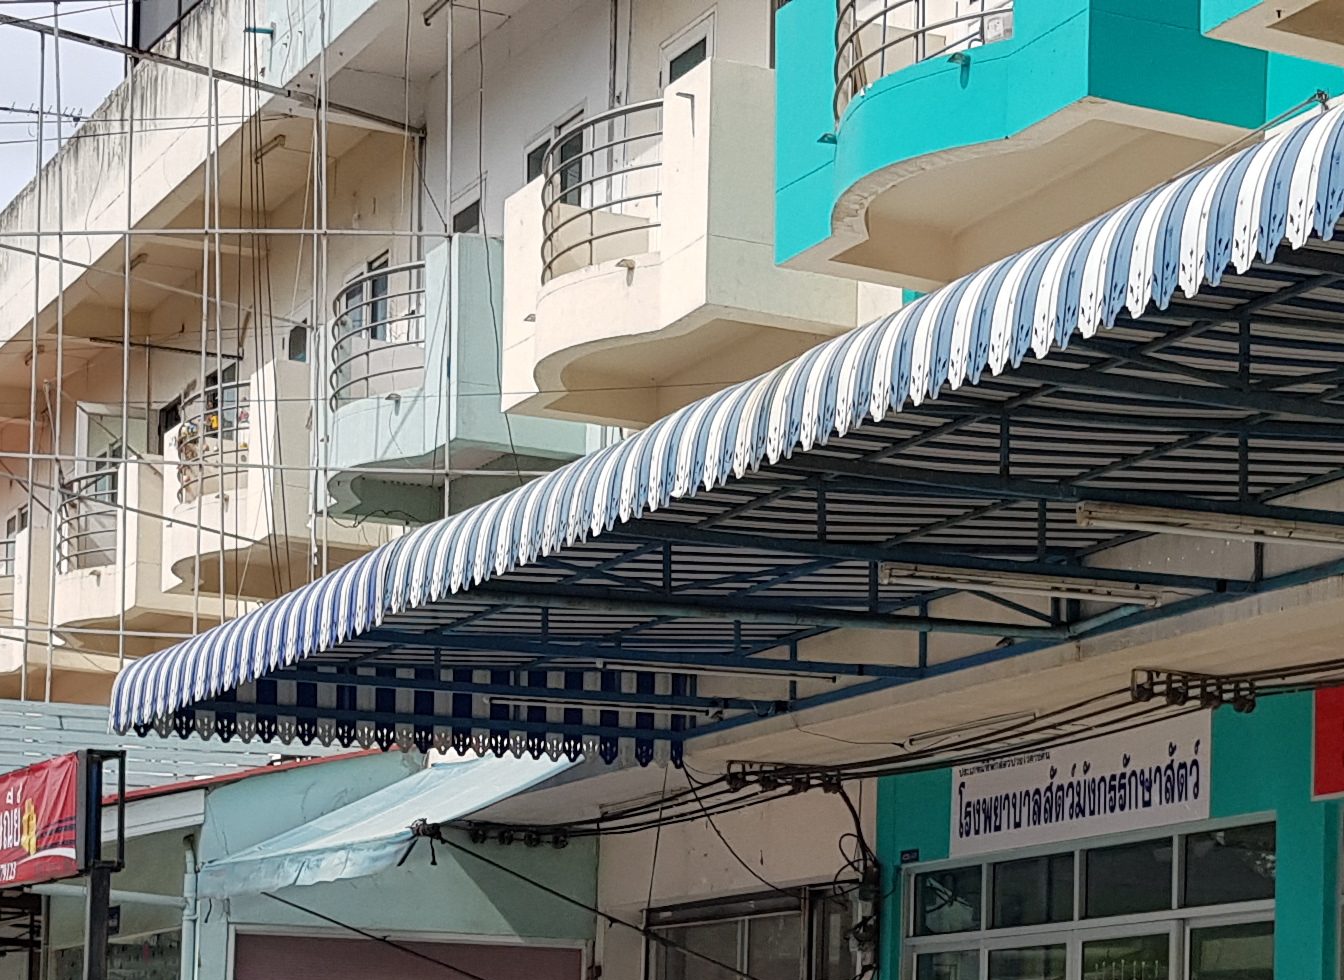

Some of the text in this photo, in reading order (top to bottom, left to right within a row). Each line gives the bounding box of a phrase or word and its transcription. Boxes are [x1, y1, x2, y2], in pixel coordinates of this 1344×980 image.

[958, 740, 1201, 839] โรงพยาบาลสัตว์มังกรรักษาสัตว์
